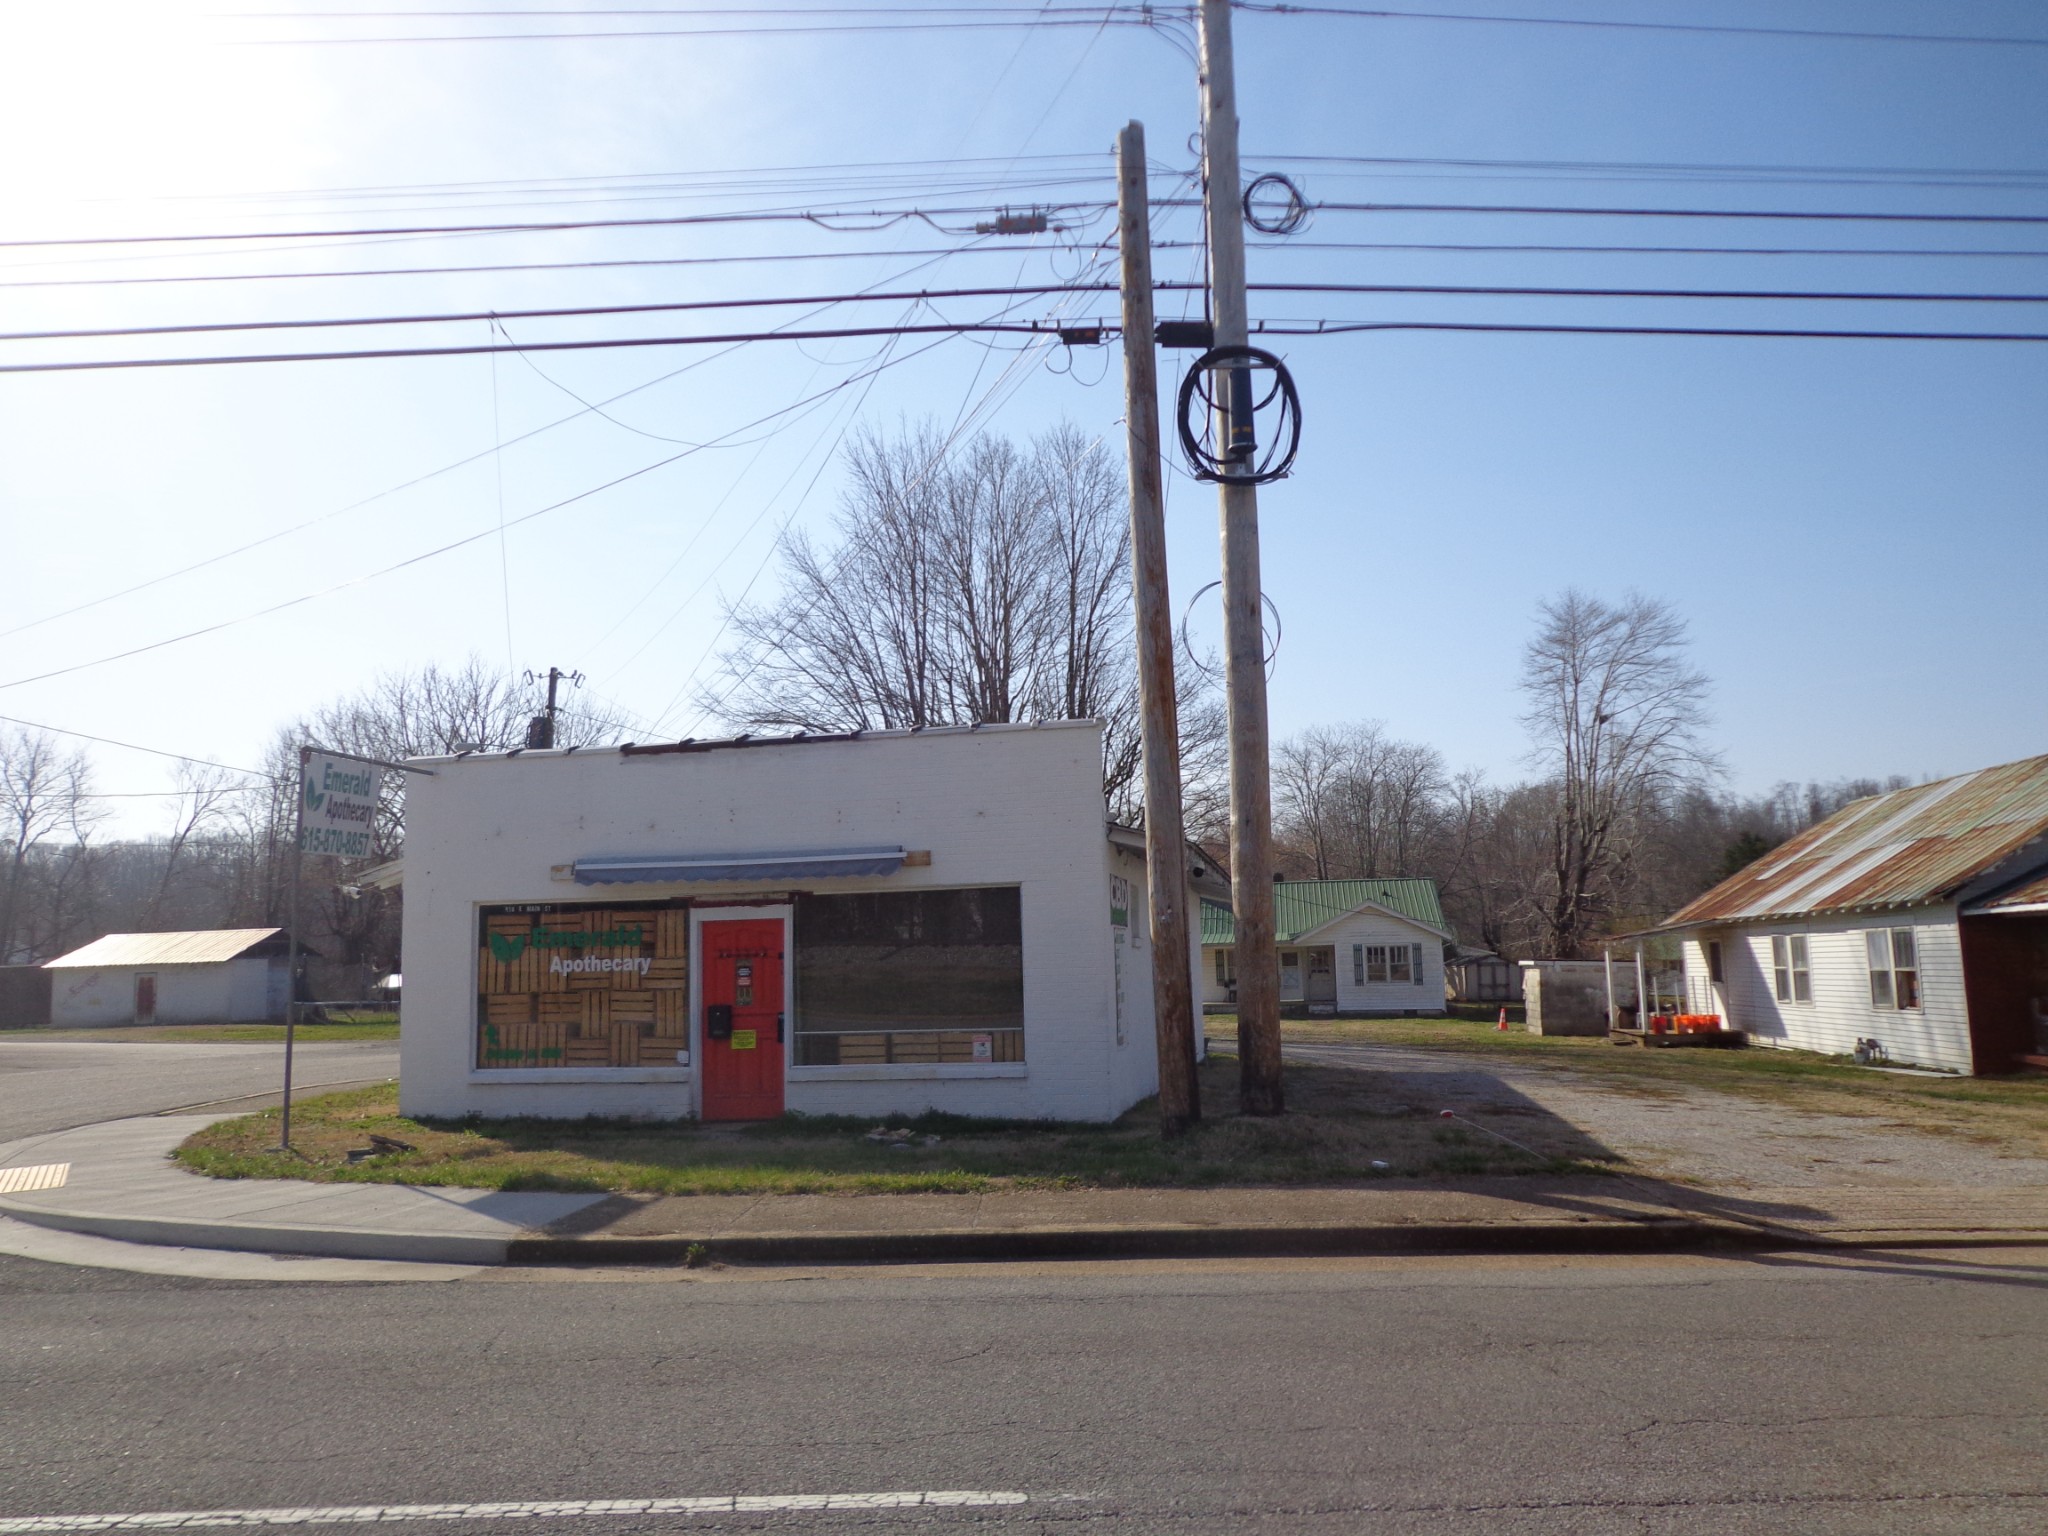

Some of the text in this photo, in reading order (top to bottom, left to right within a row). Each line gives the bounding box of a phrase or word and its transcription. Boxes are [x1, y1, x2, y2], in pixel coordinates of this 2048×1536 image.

[323, 762, 372, 797] Emerald
[325, 794, 374, 829] Apothecary
[531, 923, 643, 949] Emerald
[550, 955, 652, 977] Apothecary
